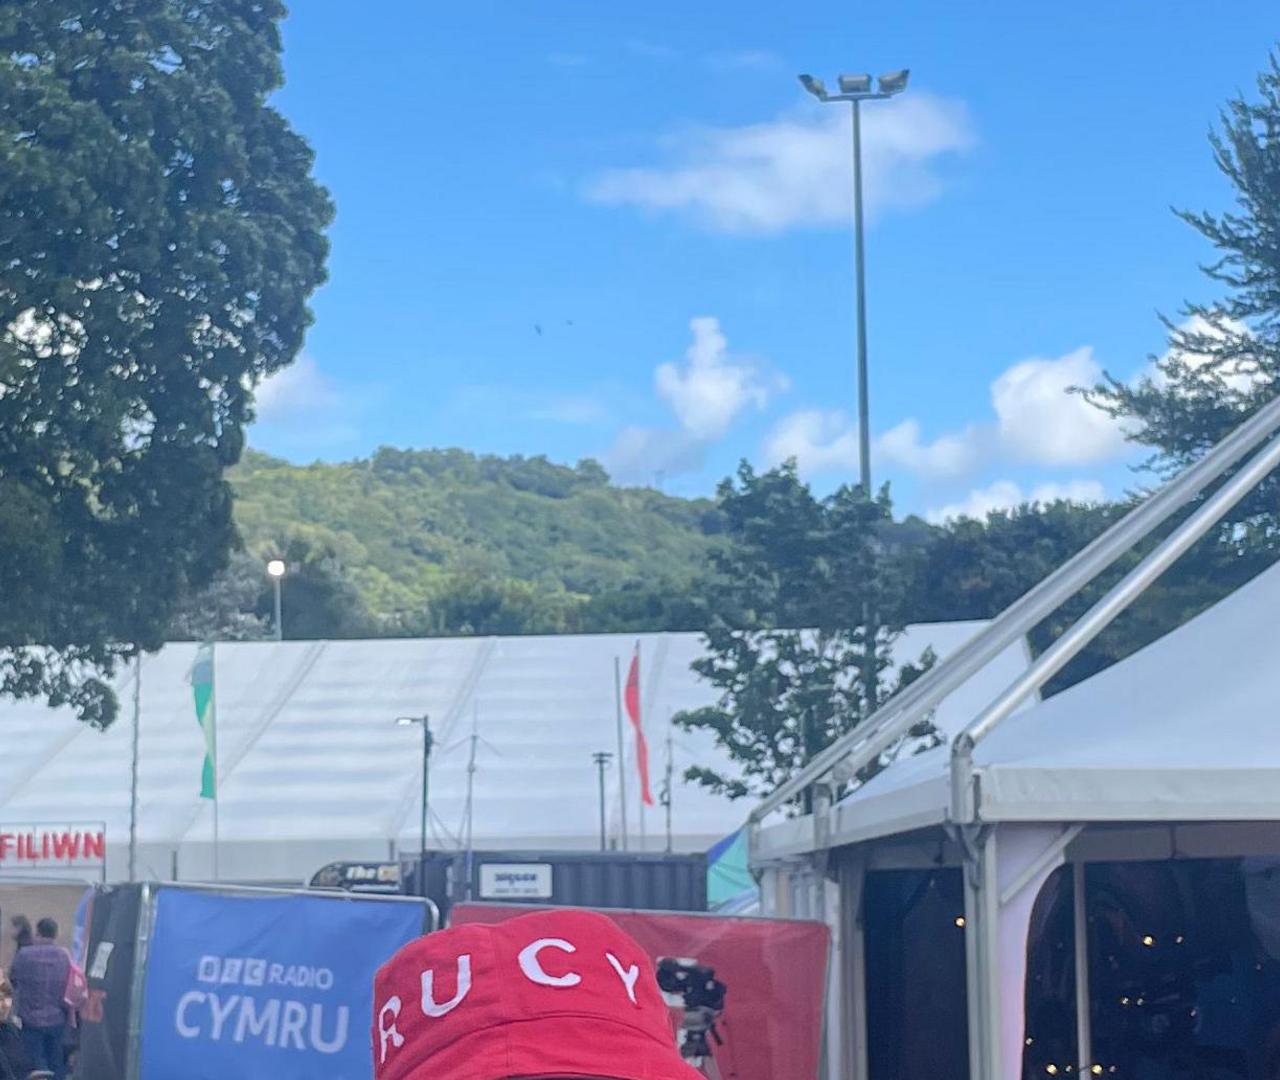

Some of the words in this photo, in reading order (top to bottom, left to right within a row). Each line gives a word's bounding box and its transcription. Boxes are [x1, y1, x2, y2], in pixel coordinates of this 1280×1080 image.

[198, 955, 267, 987] BBC
[269, 963, 334, 991] RADIO
[175, 991, 350, 1054] CYMRU
